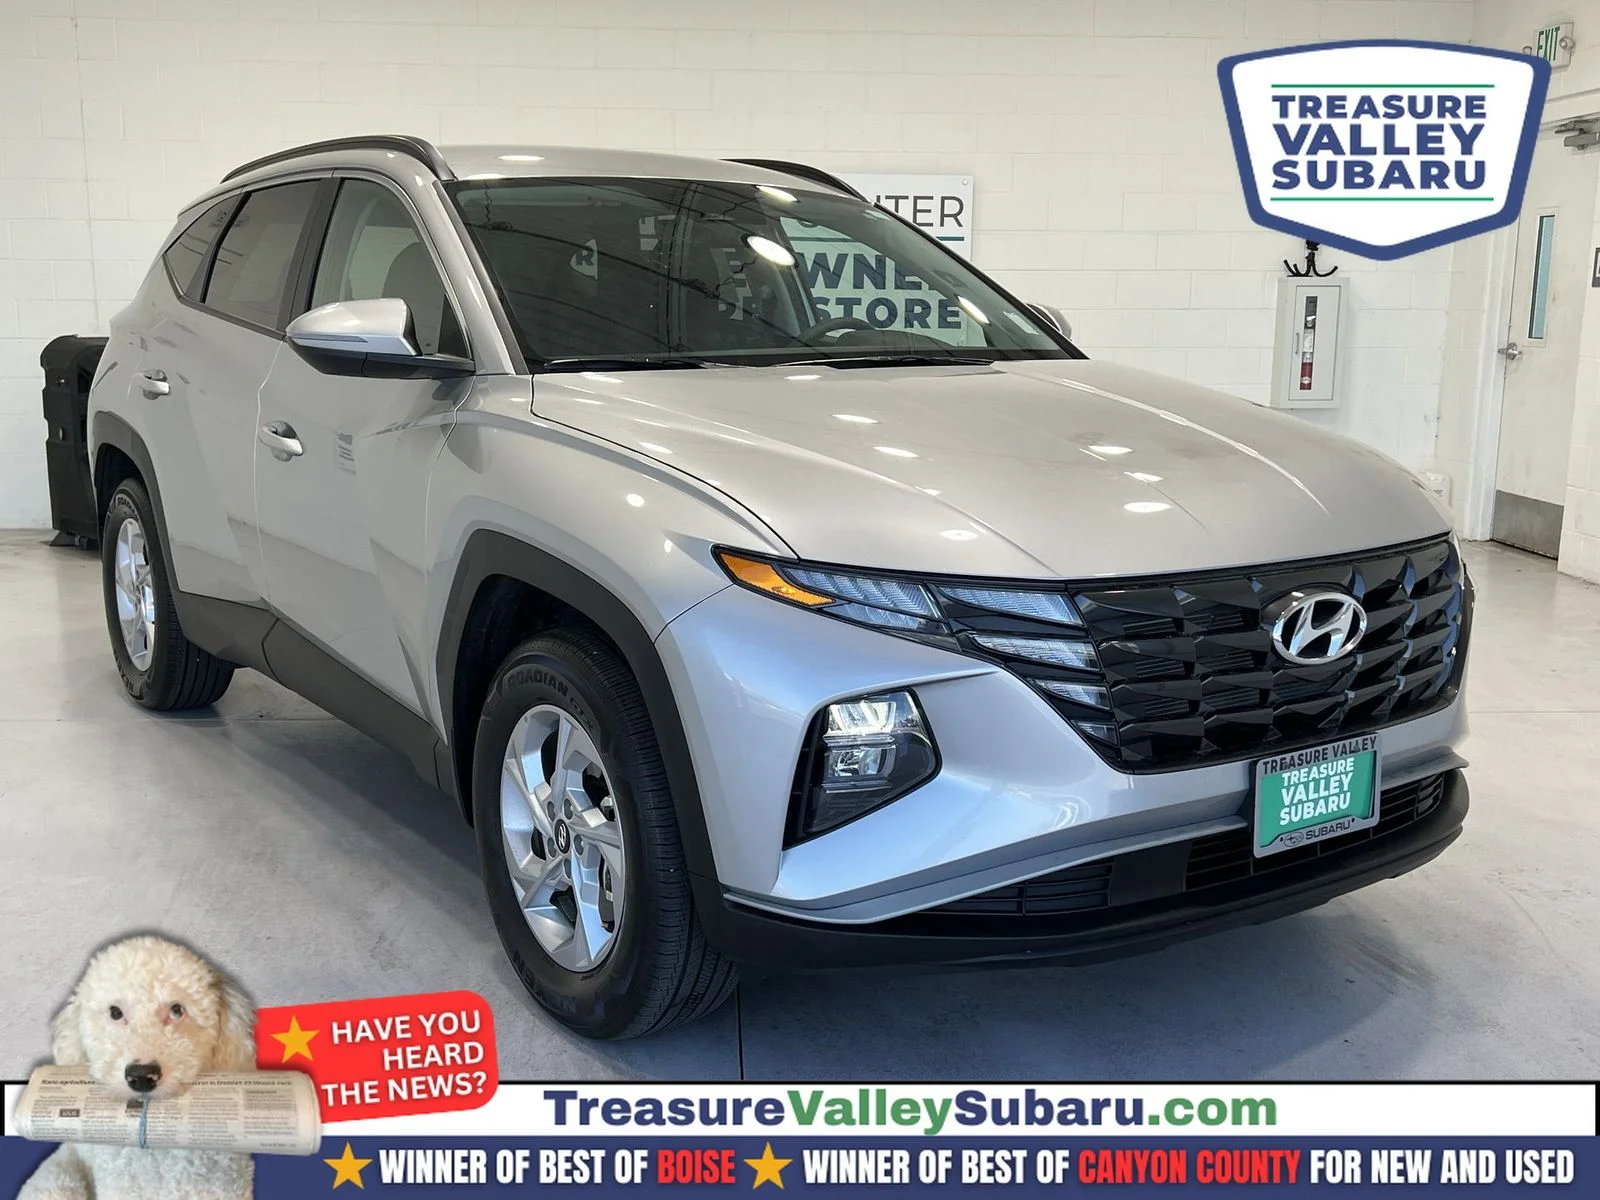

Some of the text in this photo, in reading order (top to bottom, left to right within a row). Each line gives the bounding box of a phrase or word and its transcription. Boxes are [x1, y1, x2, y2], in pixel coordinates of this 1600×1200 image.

[1537, 26, 1561, 61] EXIT
[876, 195, 964, 227] TER
[796, 252, 922, 290] WNE
[1262, 736, 1377, 775] TREASURE VALLEY
[1282, 757, 1355, 786] TREASURE
[1281, 772, 1354, 806] VALLEY
[1279, 792, 1351, 825] SUBARU
[1305, 820, 1350, 840] SUBARU
